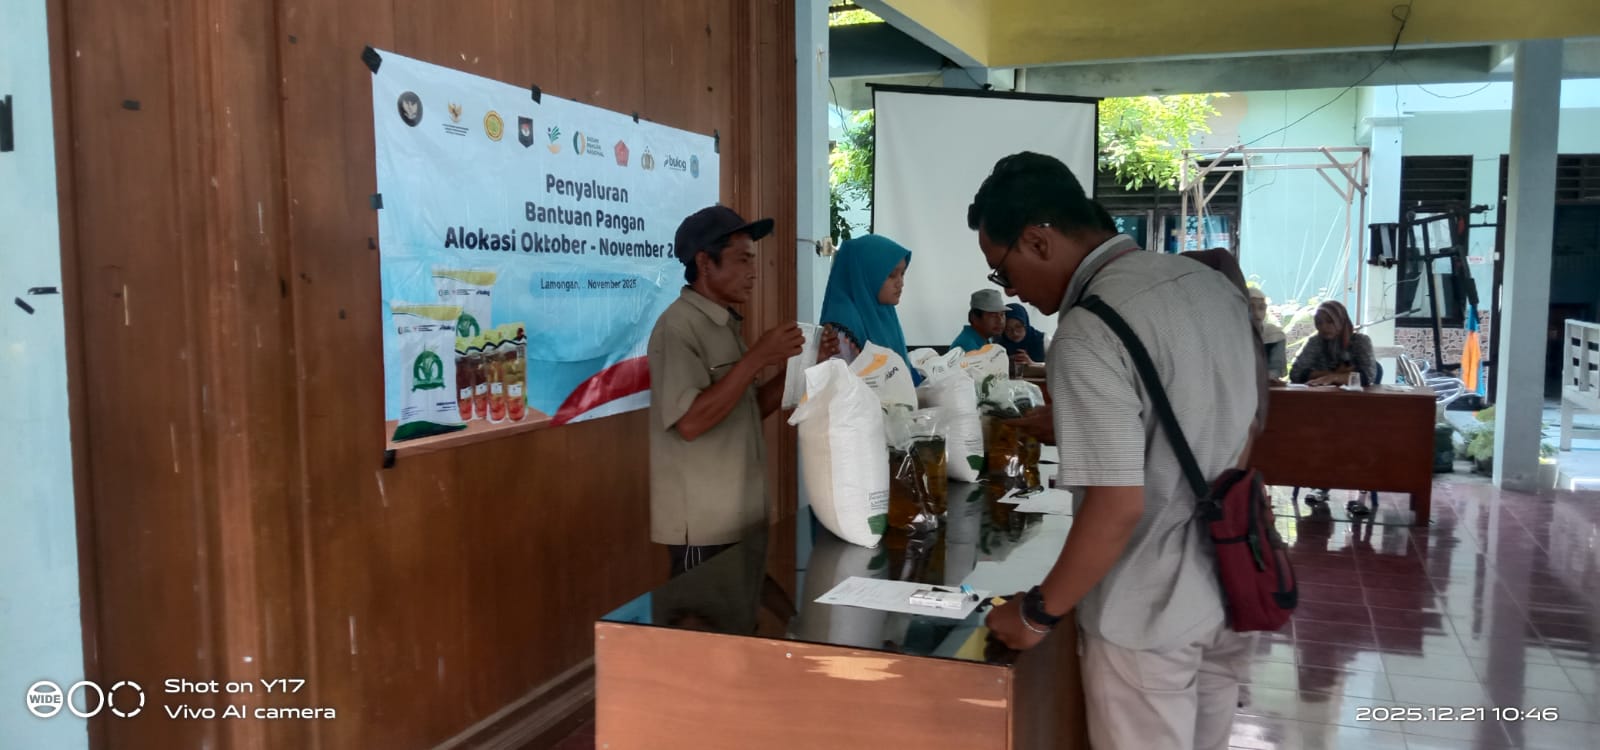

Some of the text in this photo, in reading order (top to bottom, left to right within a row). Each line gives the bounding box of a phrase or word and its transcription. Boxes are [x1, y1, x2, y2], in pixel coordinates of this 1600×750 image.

[545, 173, 629, 203] Penyaluran
[525, 201, 645, 235] Bantuan Pangan
[444, 226, 516, 252] Alokasi
[521, 231, 587, 255] Oktober
[599, 237, 664, 259] November
[587, 279, 621, 290] November
[622, 279, 637, 290] 2025
